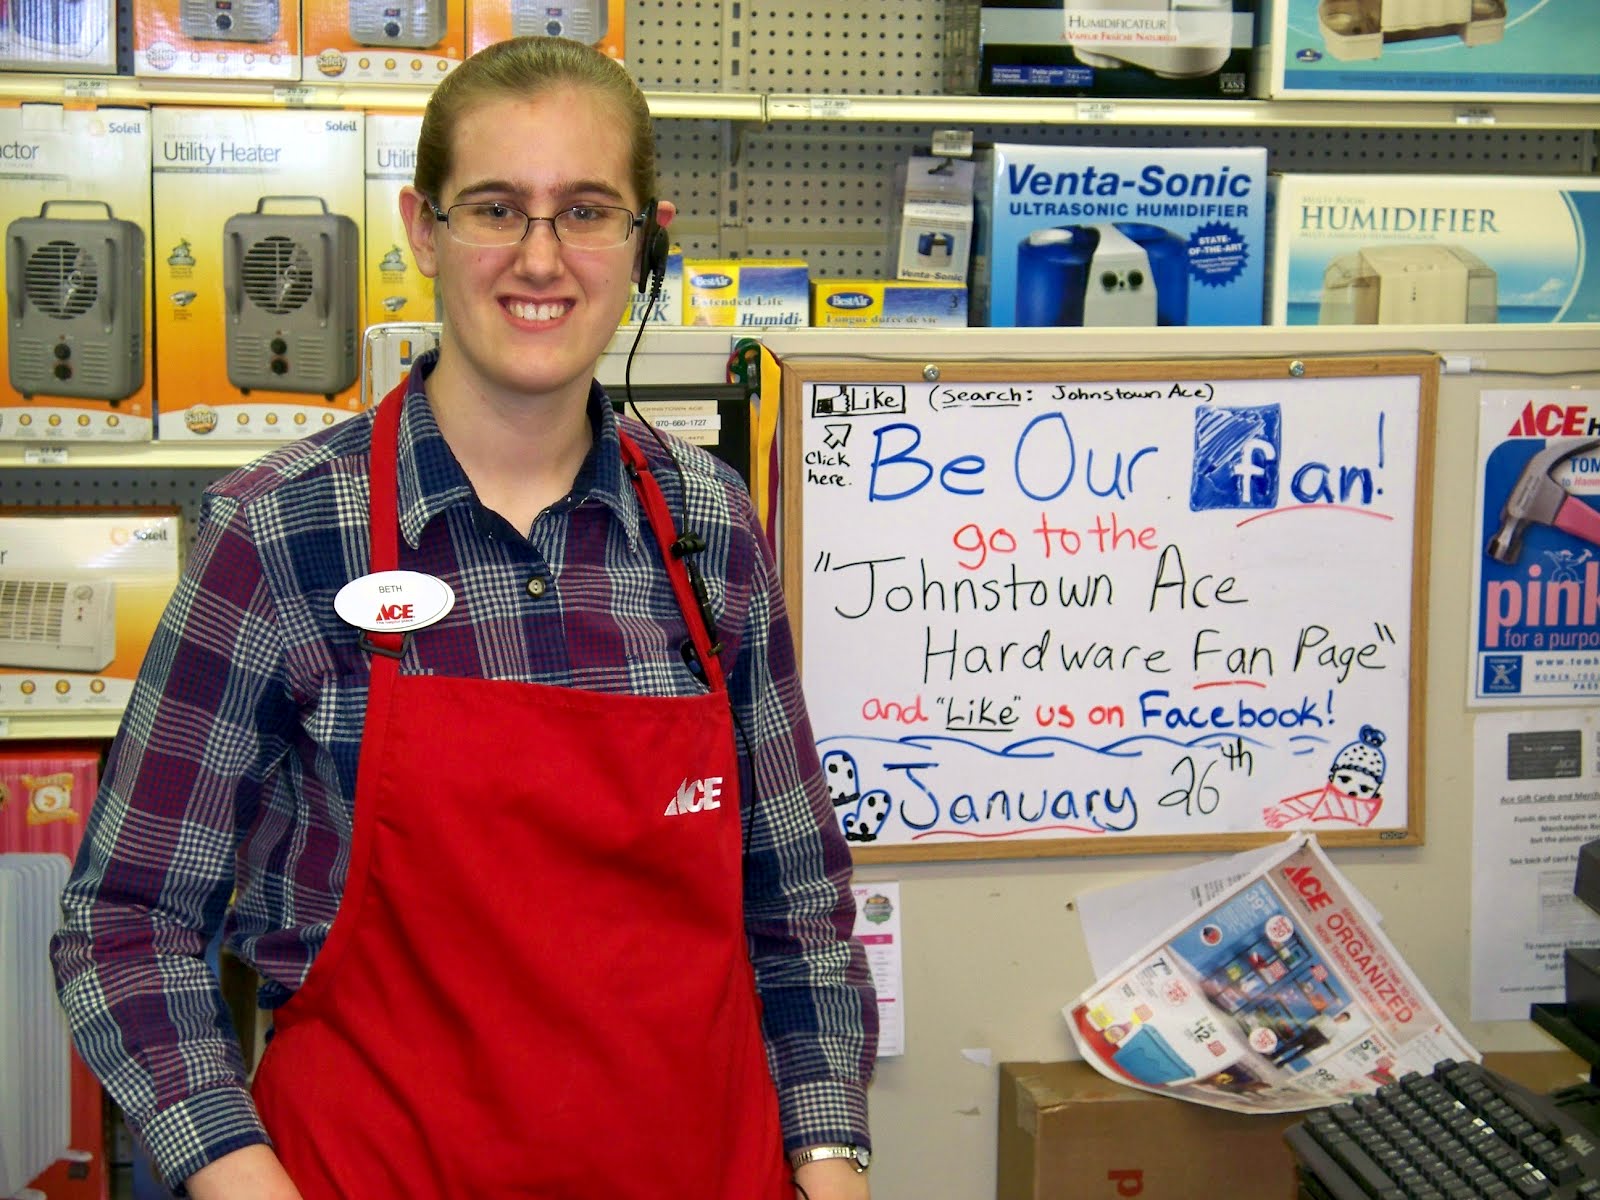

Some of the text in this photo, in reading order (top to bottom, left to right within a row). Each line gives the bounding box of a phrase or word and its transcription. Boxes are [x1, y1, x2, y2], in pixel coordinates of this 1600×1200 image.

[1069, 14, 1167, 29] HUMIDIFICATEUR
[108, 122, 141, 134] Soleil
[325, 120, 357, 132] Soleil
[164, 142, 282, 166] Utility Heater
[1008, 163, 1252, 197] Venta-Sonic
[1009, 202, 1249, 217] ULTRASONIC HUMIDIFIER
[1301, 206, 1500, 233] HUMIDIFIER
[1188, 243, 1243, 256] OF-THE-ART
[1199, 235, 1231, 246] STATE-
[695, 275, 732, 288] BestAir
[902, 269, 963, 282] Venta-Sonic
[757, 296, 784, 308] Life
[832, 294, 872, 308] BestAir
[742, 311, 803, 326] Humidi-
[906, 313, 922, 324] de
[852, 387, 899, 411] Like
[1052, 384, 1161, 401] Johnstown
[1168, 382, 1215, 403] Ace)
[655, 419, 707, 428] 970-660-1727
[1508, 400, 1588, 437] ACE
[868, 422, 986, 503] Be
[1014, 411, 1159, 502] Our
[952, 511, 1159, 571] go to the
[1152, 543, 1249, 613] Ace
[379, 585, 403, 594] BETH
[375, 603, 415, 621] ACE
[1505, 628, 1528, 648] for
[1533, 633, 1543, 647] a
[924, 625, 1171, 684] Hardware
[1193, 629, 1274, 677] Fan
[861, 694, 929, 725] and
[1035, 703, 1076, 729] us
[1088, 704, 1125, 728] on
[1138, 689, 1336, 729] Facebook!
[664, 776, 723, 817] ACE
[883, 762, 1138, 832] January
[1283, 866, 1334, 914] ACE
[1325, 912, 1414, 1026] ORGANIZED
